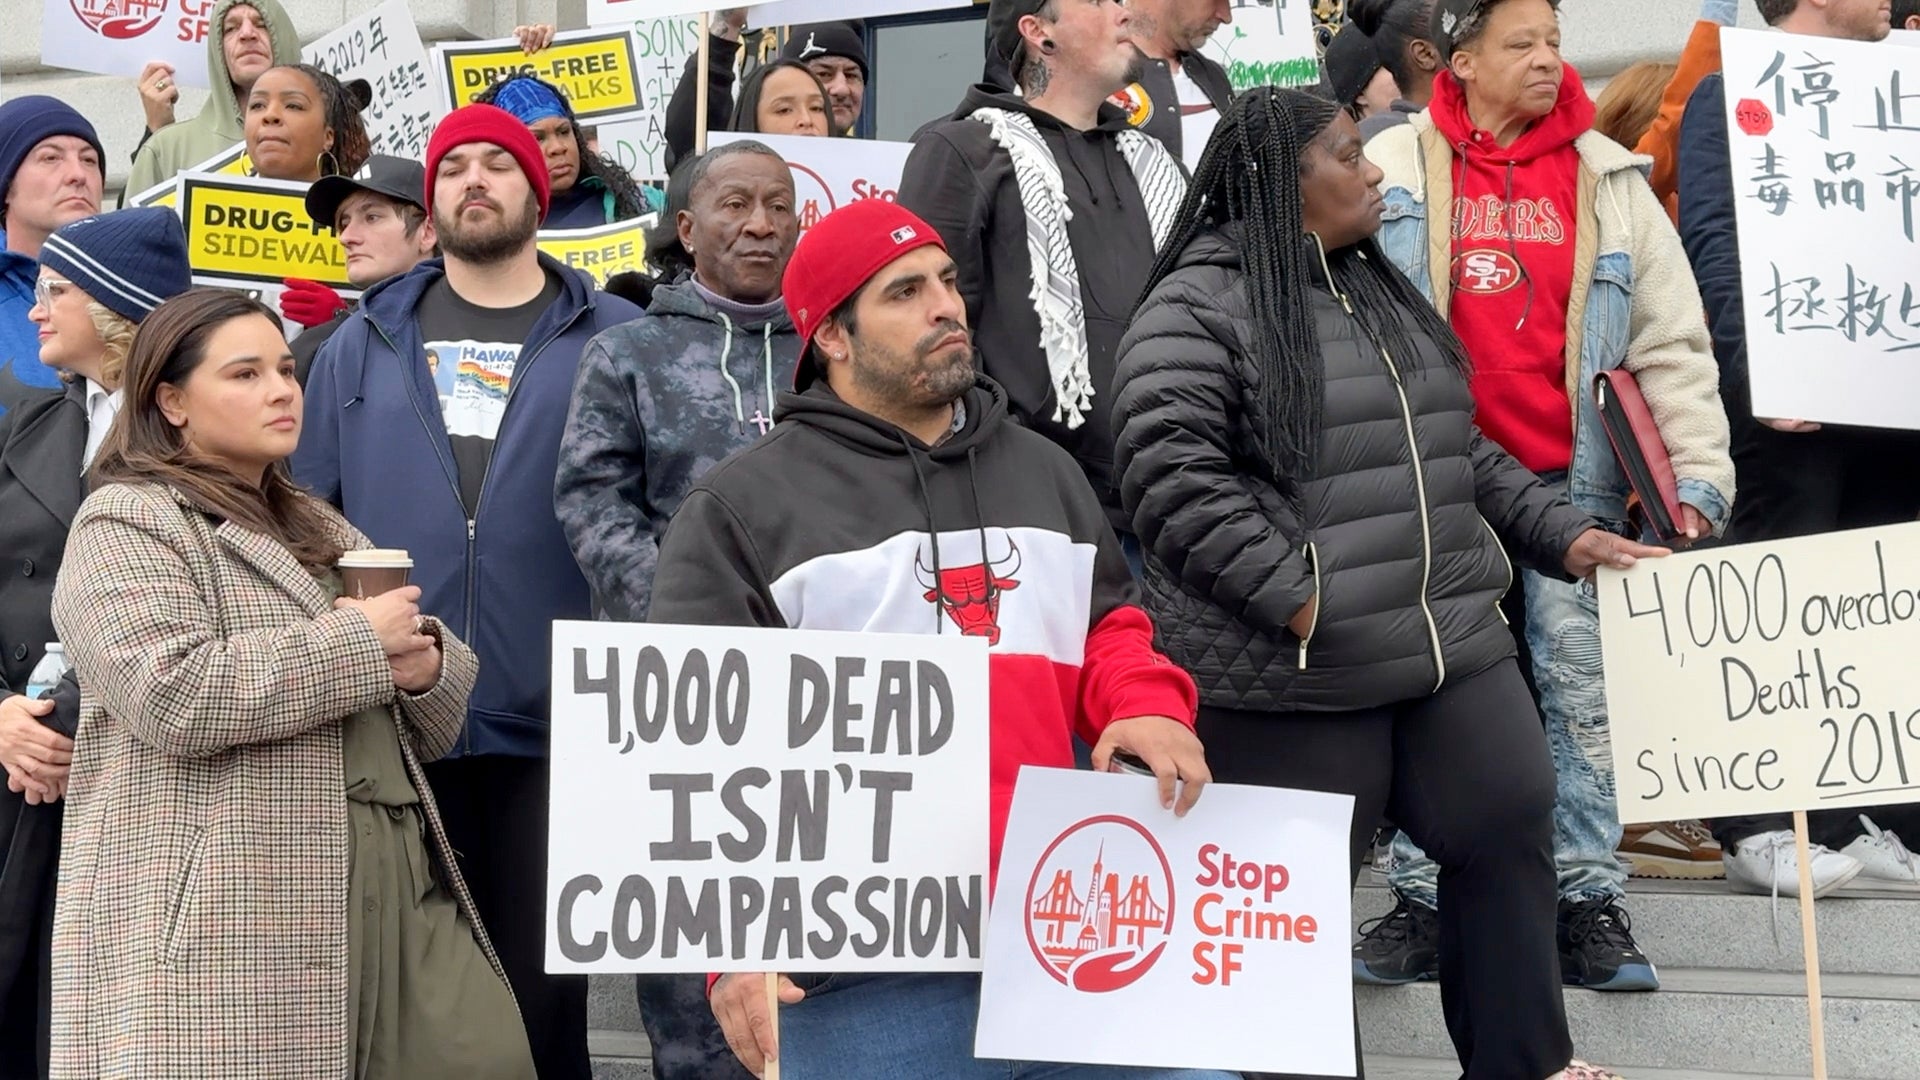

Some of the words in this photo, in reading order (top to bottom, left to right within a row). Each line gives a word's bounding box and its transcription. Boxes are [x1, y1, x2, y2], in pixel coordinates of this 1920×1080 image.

[1737, 111, 1768, 124] STOP
[1465, 253, 1511, 289] SF
[1622, 553, 1788, 668] 4,000
[1801, 540, 1920, 636] overdo
[573, 645, 751, 754] 4,000
[788, 653, 955, 756] DEAD
[1721, 647, 1861, 721] Deaths
[1637, 737, 1784, 800] since
[648, 763, 913, 863] ISN'T
[1195, 843, 1290, 903] Stop
[557, 874, 983, 963] COMPASSION
[1193, 892, 1318, 943] Crime
[1191, 941, 1244, 986] SF
